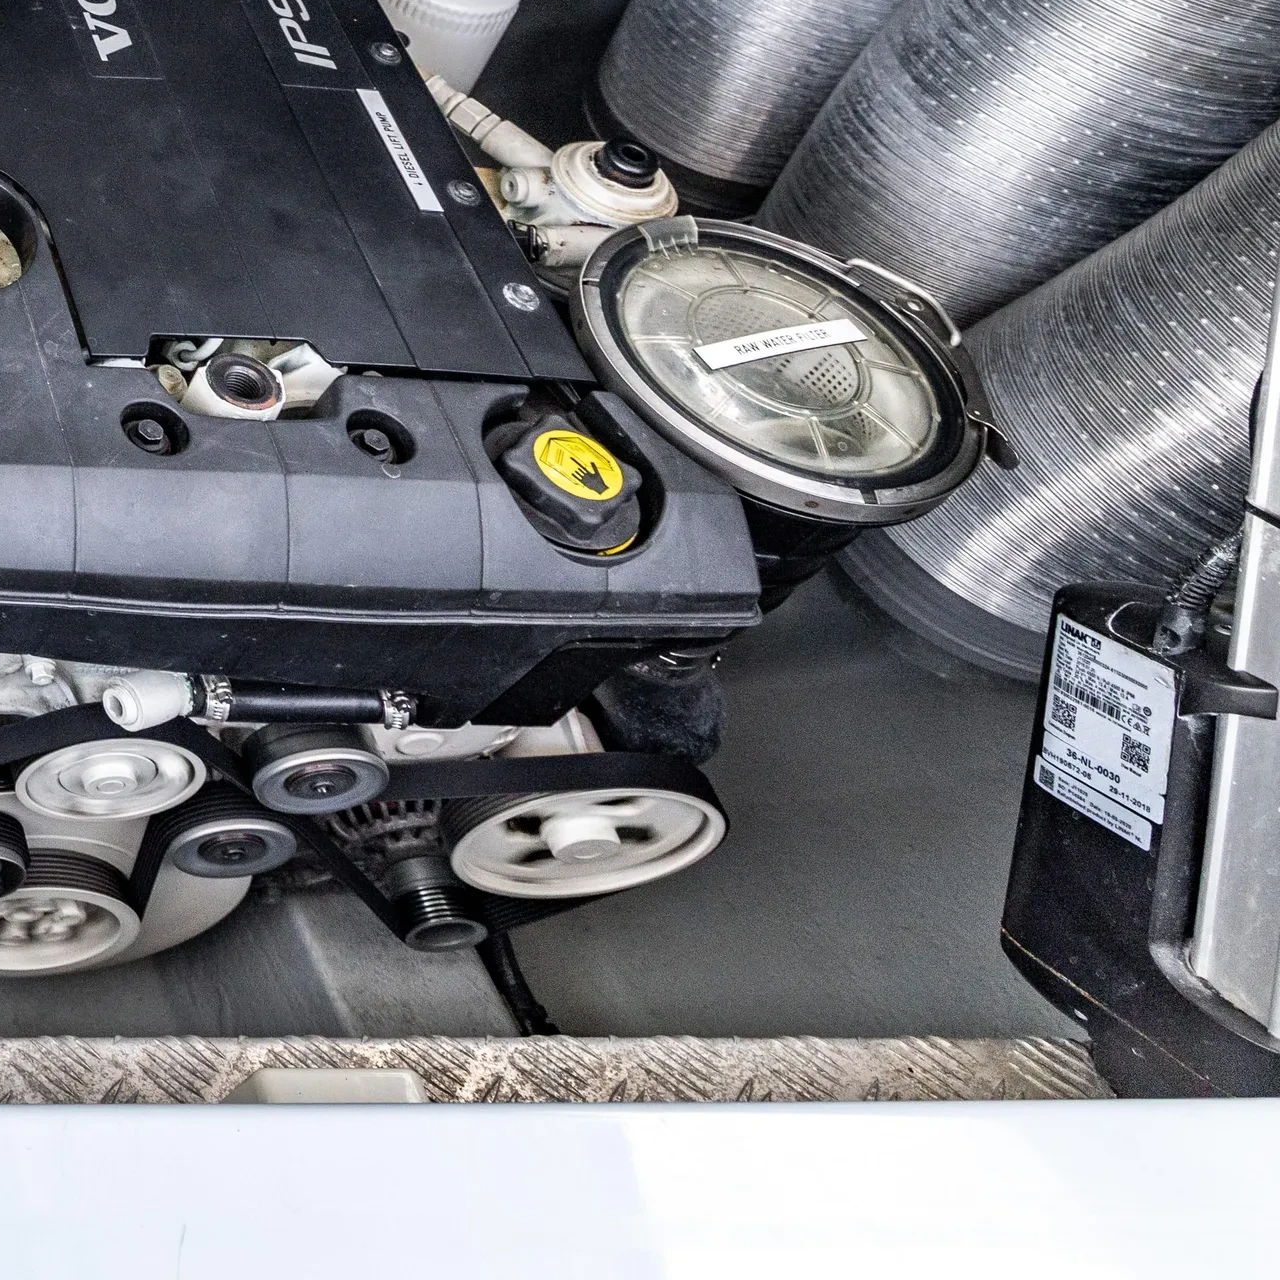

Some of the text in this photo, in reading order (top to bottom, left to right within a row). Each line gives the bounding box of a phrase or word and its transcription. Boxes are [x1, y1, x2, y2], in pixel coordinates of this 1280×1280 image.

[375, 111, 420, 179] DIESEL LIFT PUMP
[733, 328, 831, 355] RAW WATER FILTER
[1060, 620, 1088, 643] LINAK
[1066, 748, 1121, 784] 36-NL-0030
[1109, 785, 1151, 813] 29-11-2018
